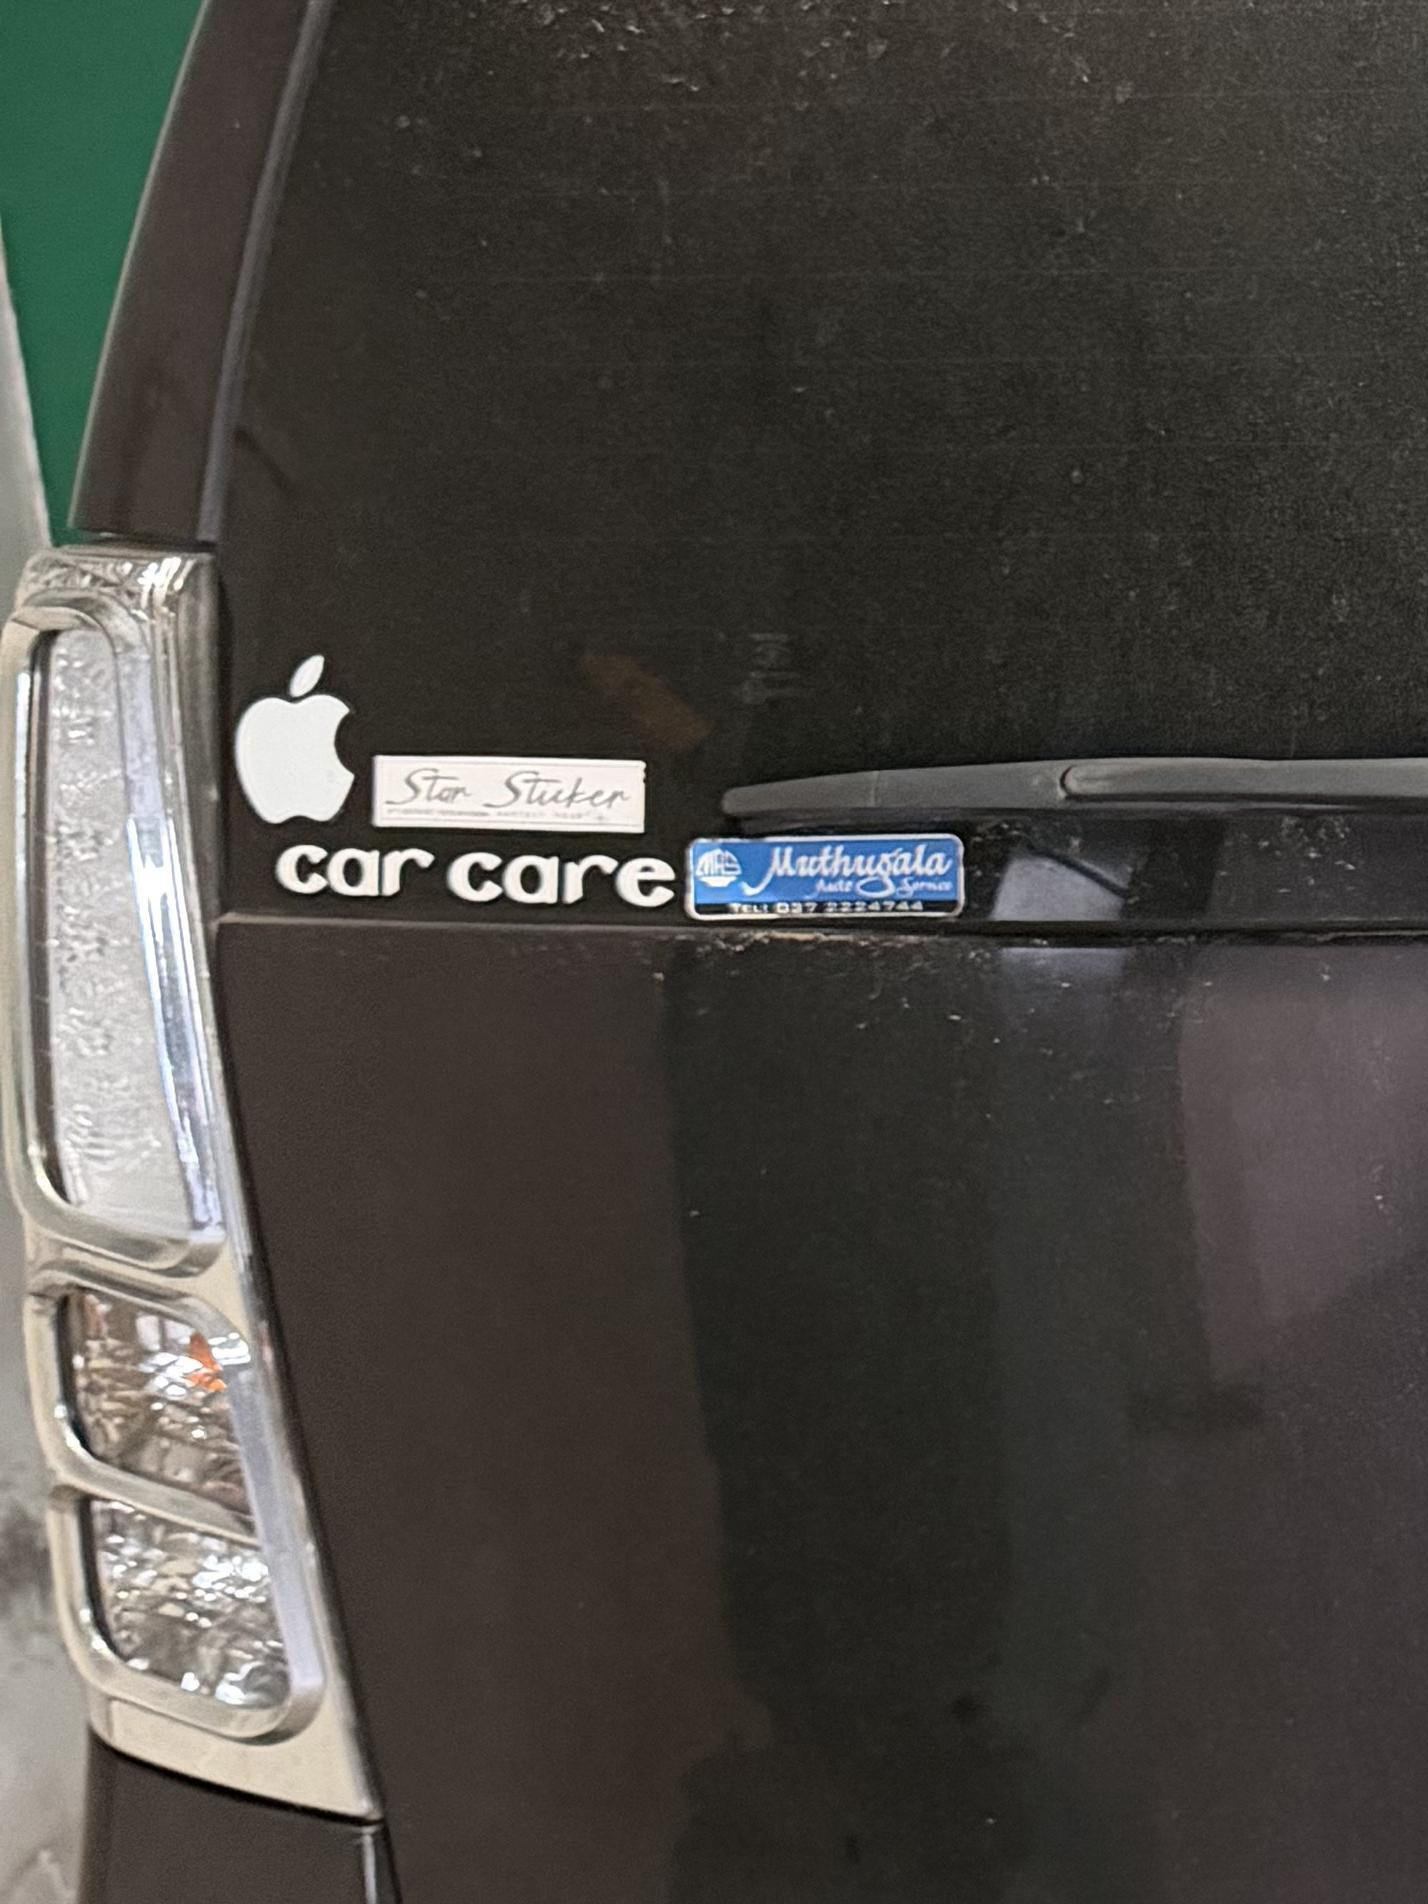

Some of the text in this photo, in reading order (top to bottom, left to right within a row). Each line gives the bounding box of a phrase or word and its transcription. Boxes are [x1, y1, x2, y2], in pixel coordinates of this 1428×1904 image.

[384, 767, 472, 806] Star
[275, 841, 677, 908] car care
[741, 843, 954, 899] Muthugala
[774, 901, 819, 914] 037
